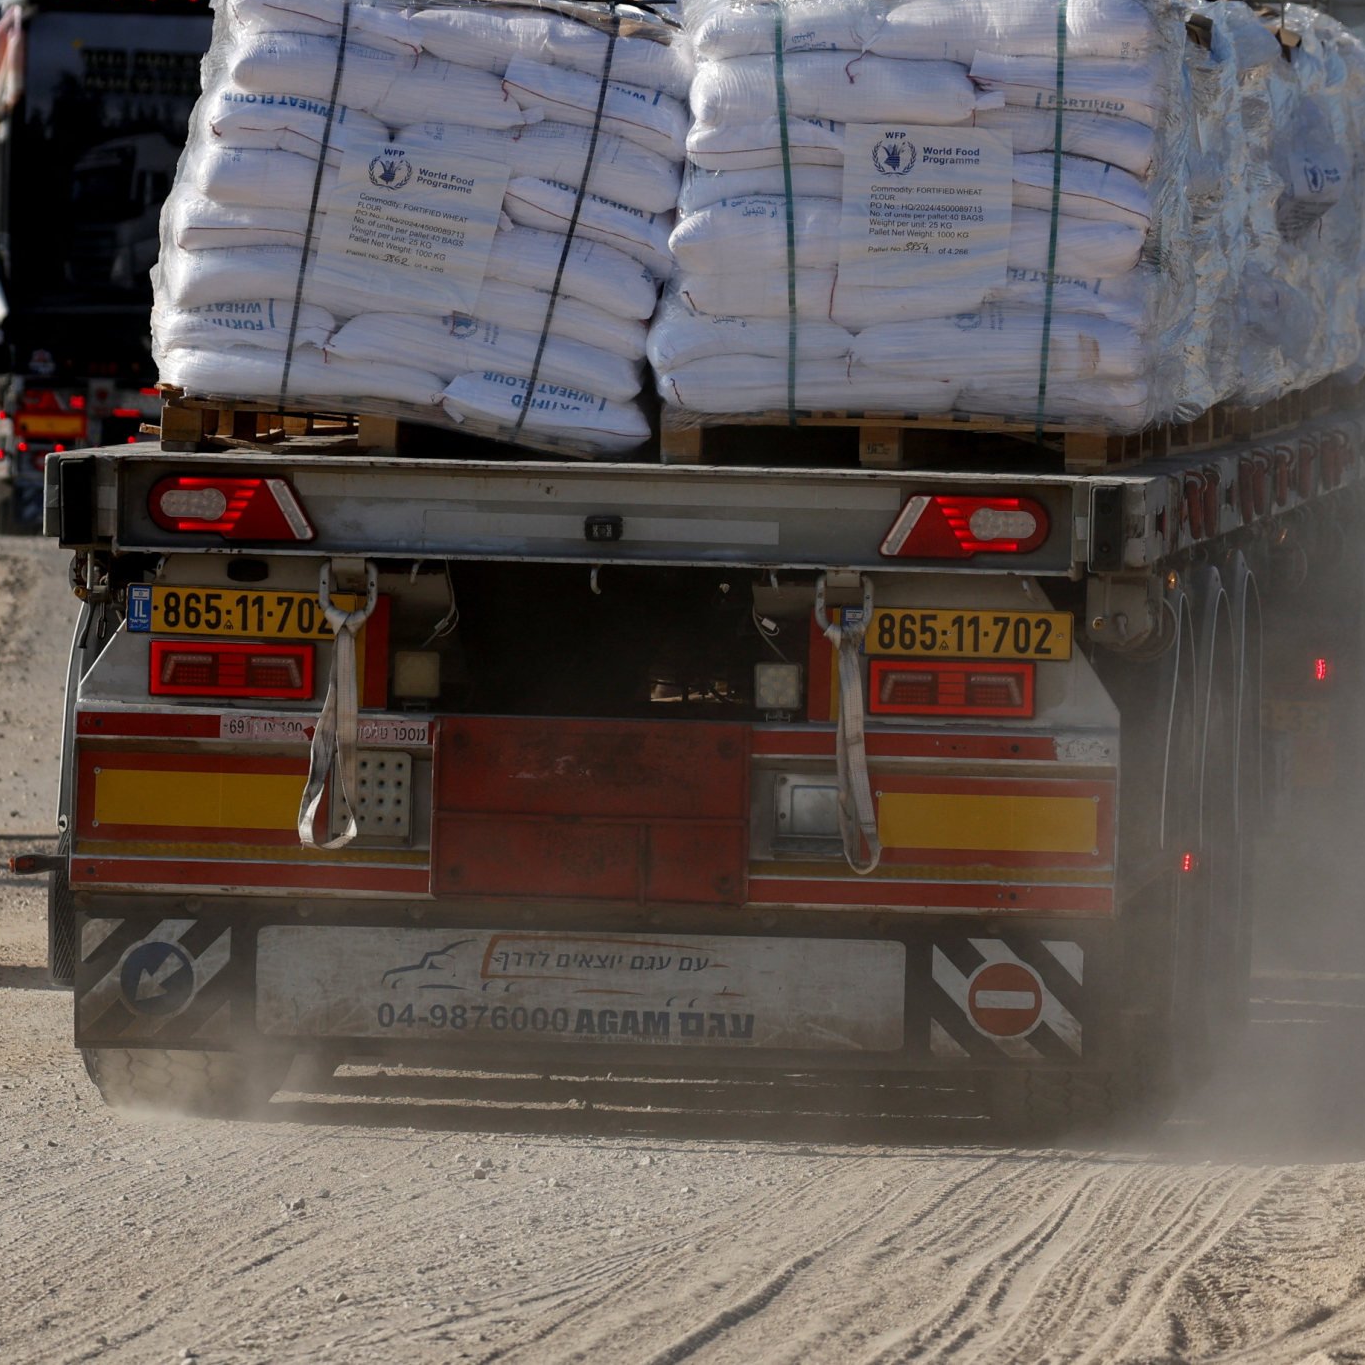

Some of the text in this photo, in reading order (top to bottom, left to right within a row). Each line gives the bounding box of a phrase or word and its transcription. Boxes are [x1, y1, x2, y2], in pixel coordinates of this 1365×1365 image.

[224, 91, 334, 119] WHEAT FLOUR
[384, 148, 405, 158] WFP
[923, 146, 980, 156] World Food
[922, 155, 980, 166] Programme
[416, 176, 473, 195] Programme
[419, 168, 475, 187] World Food
[871, 185, 914, 194] Commodity:
[916, 186, 955, 194] FORTIFIED
[357, 201, 382, 213] FLOUR
[403, 203, 442, 218] FORTIFIED
[442, 212, 469, 224] WHEAT
[869, 219, 895, 227] Weight
[960, 214, 984, 222] BAGS
[351, 224, 375, 238] Weight
[377, 230, 391, 241] per
[419, 240, 433, 249] KG
[377, 221, 394, 231] units
[395, 226, 408, 236] per
[441, 235, 465, 247] BAGS
[869, 227, 890, 236] Pallet
[349, 233, 369, 245] Pallet
[371, 238, 384, 248] Net
[433, 251, 447, 261] KG
[205, 302, 262, 314] WHEAT
[537, 383, 595, 405] WHEAT
[134, 600, 147, 618] IL
[393, 725, 426, 741] מספר
[497, 950, 710, 971] עם עגם יוצאים לדרך
[377, 1002, 755, 1039] 04-9876000 AGAM עגם
